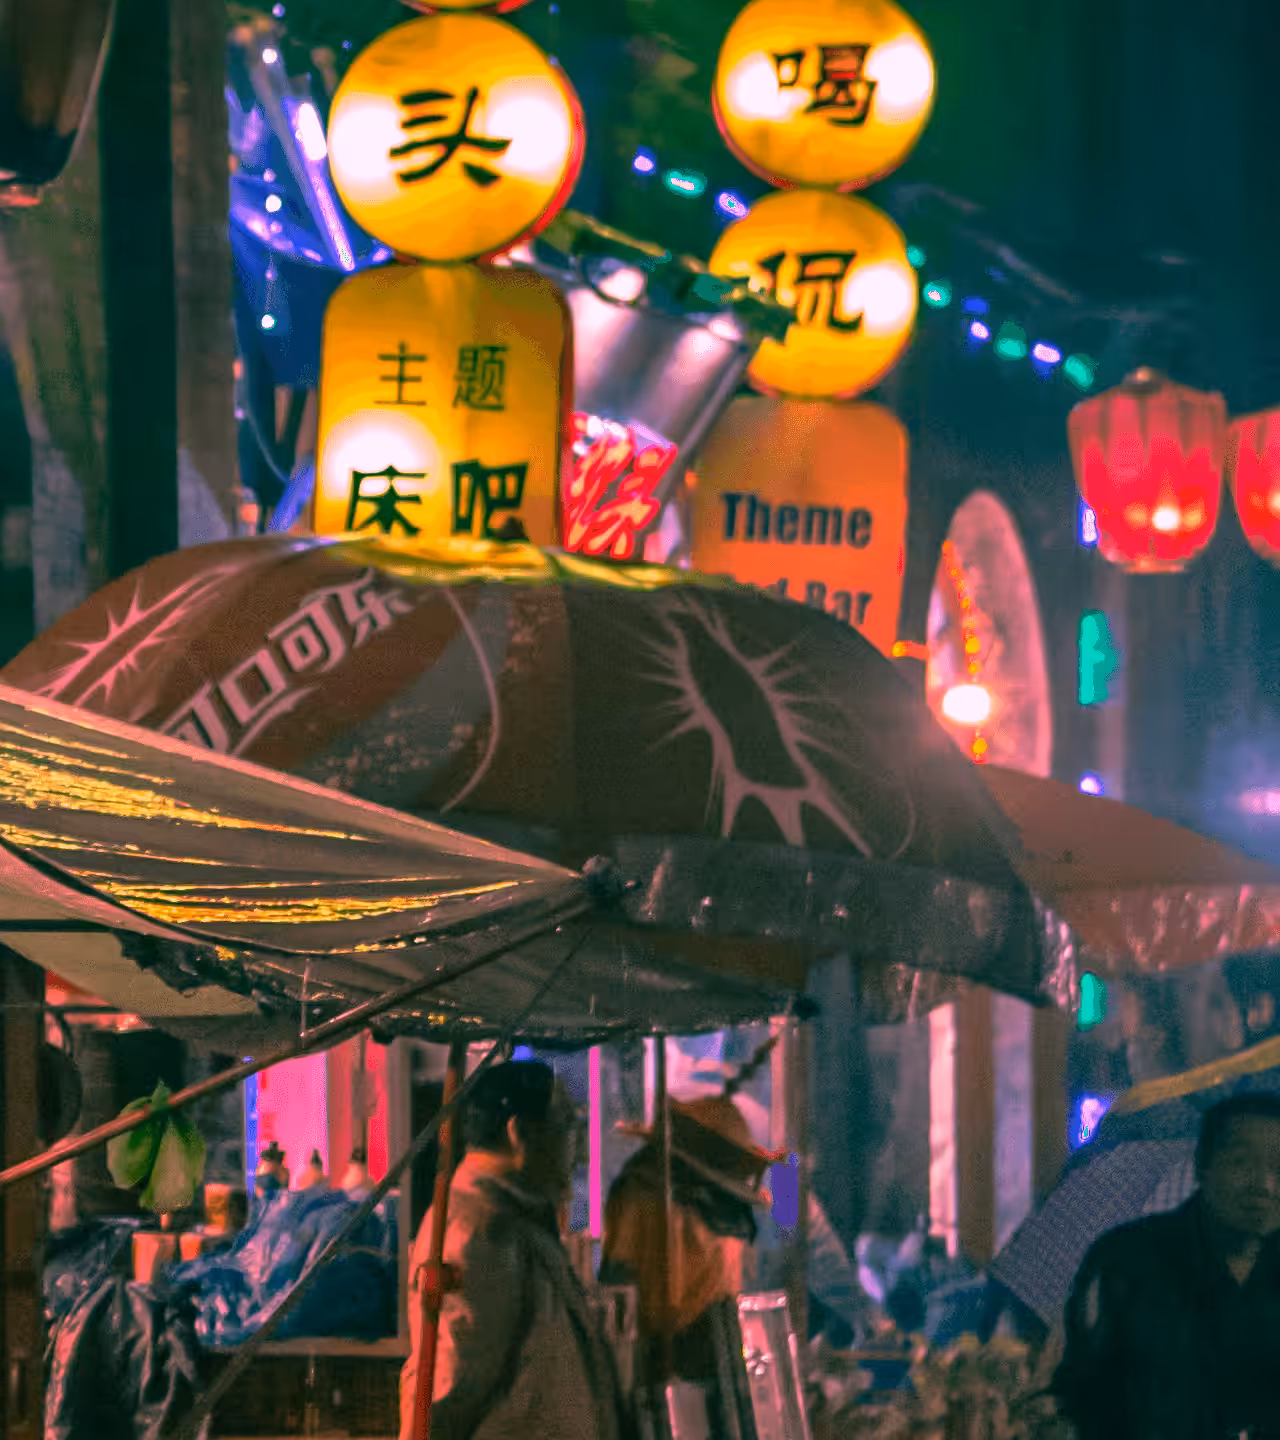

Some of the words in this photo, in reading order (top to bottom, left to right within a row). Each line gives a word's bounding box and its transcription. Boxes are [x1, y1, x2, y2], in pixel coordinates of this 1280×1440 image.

[373, 340, 509, 411] 主题
[344, 459, 529, 539] 床吧
[721, 491, 873, 550] Theme
